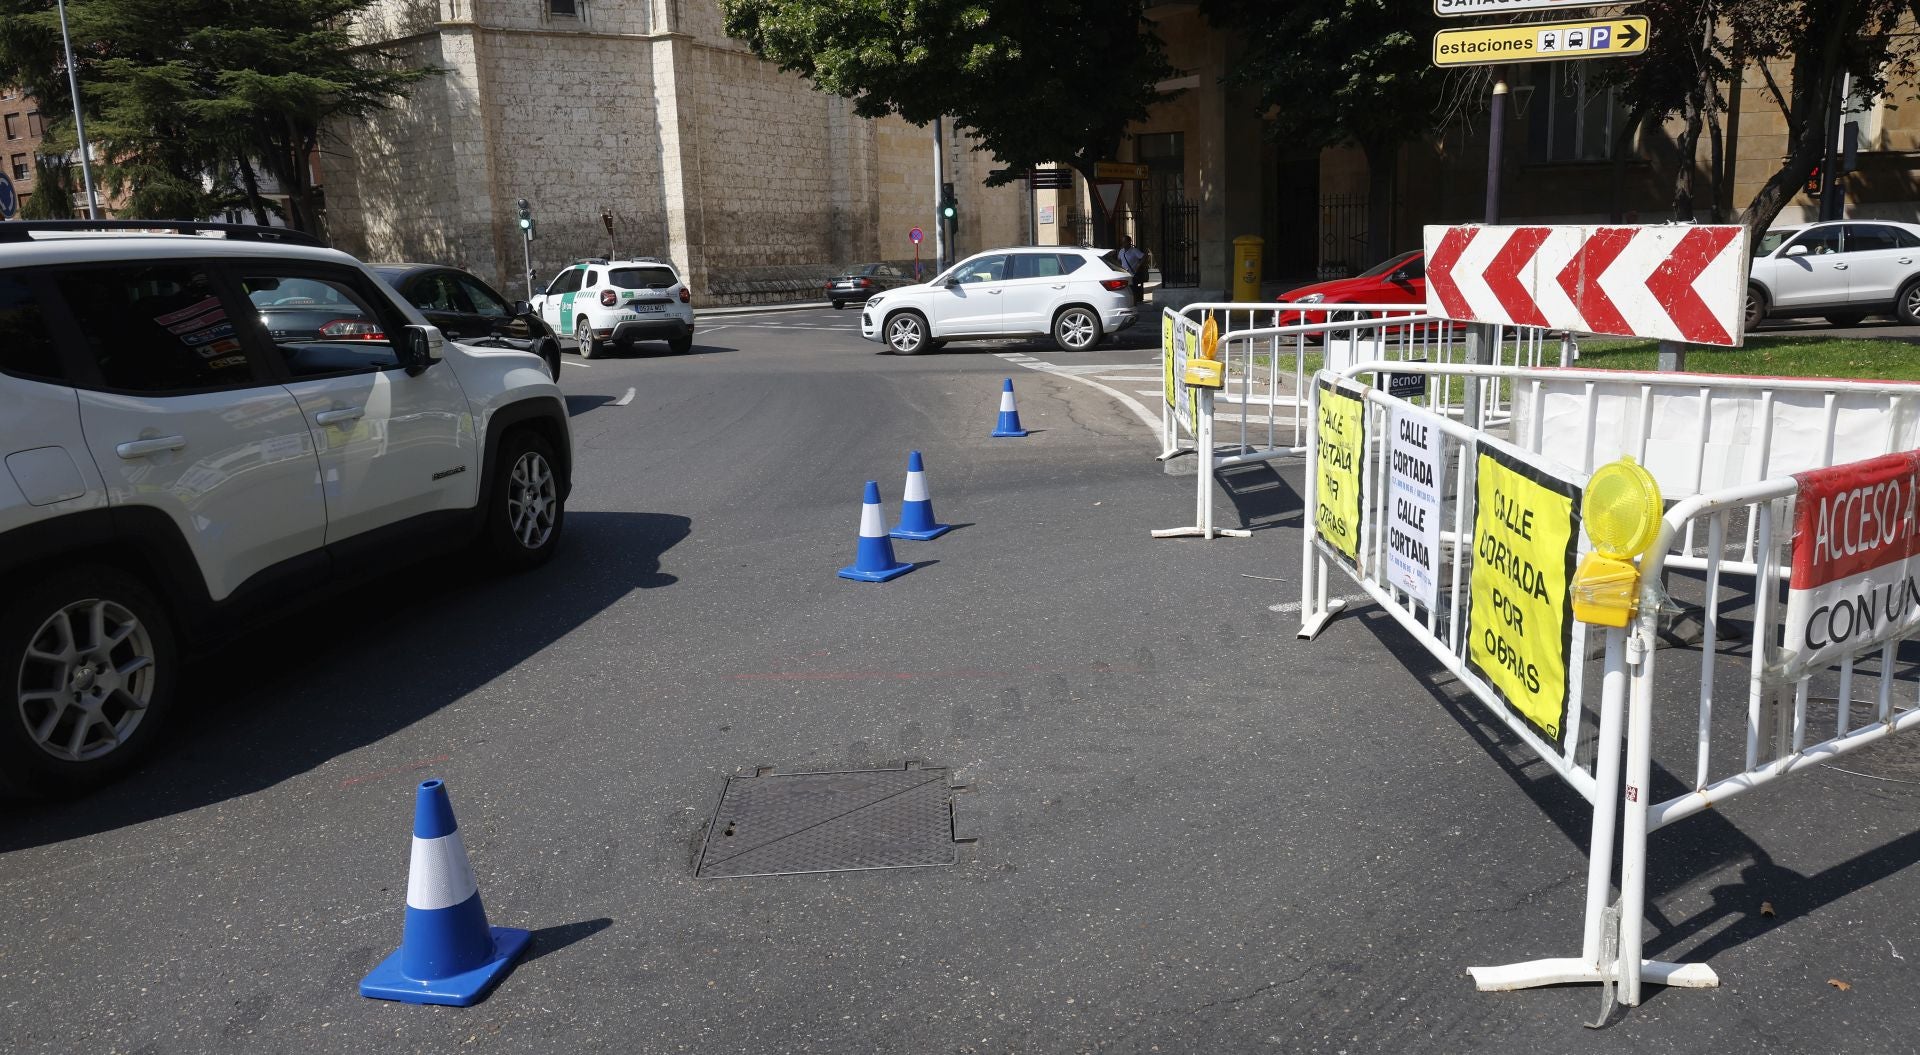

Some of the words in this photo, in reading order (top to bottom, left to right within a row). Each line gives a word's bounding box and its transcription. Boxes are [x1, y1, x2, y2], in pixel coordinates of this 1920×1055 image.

[1440, 38, 1533, 55] estaciones
[1400, 418, 1427, 450] CALLE
[1393, 449, 1433, 488] CORTADA
[1396, 497, 1425, 533] CALLE
[1494, 488, 1534, 542] CALLE
[1812, 479, 1900, 566] ACCESO
[1390, 526, 1430, 570] CORTADA
[1480, 528, 1550, 605] CORTADA
[1493, 587, 1523, 637] POR
[1805, 589, 1877, 650] CON
[1485, 628, 1540, 694] OBRAS
